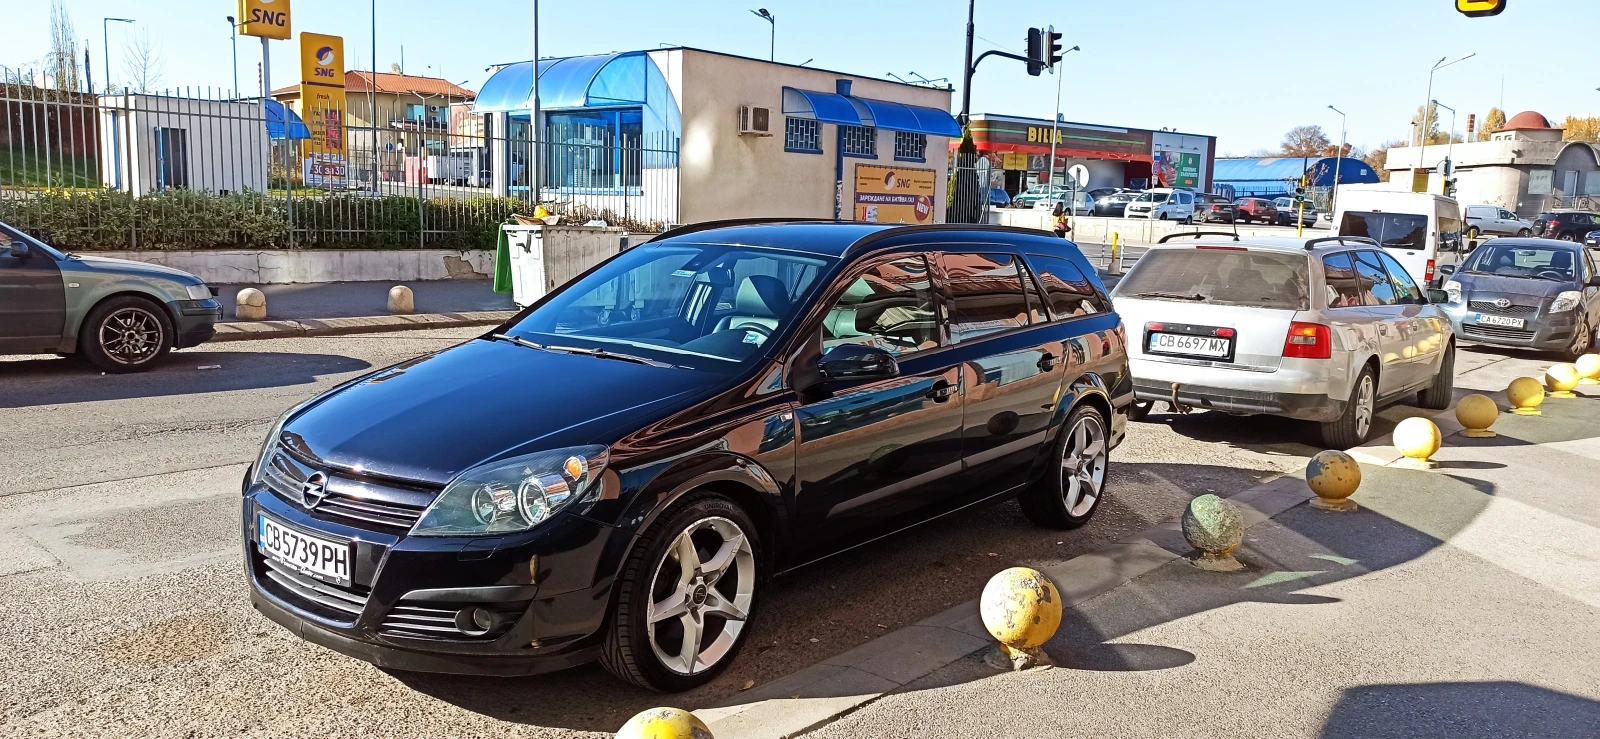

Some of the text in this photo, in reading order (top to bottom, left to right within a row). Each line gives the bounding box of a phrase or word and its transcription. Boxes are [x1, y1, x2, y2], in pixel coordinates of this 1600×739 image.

[252, 9, 286, 27] SNG
[314, 67, 335, 78] SNG
[316, 92, 330, 100] fresh
[1028, 126, 1063, 145] BILLA
[897, 178, 911, 188] SNG
[859, 194, 885, 203] ЗАРЕЖДАНЕ
[916, 201, 930, 215] NEW
[1159, 334, 1227, 352] CB 6697 MX
[282, 530, 319, 568] 5739
[321, 544, 347, 576] PH
